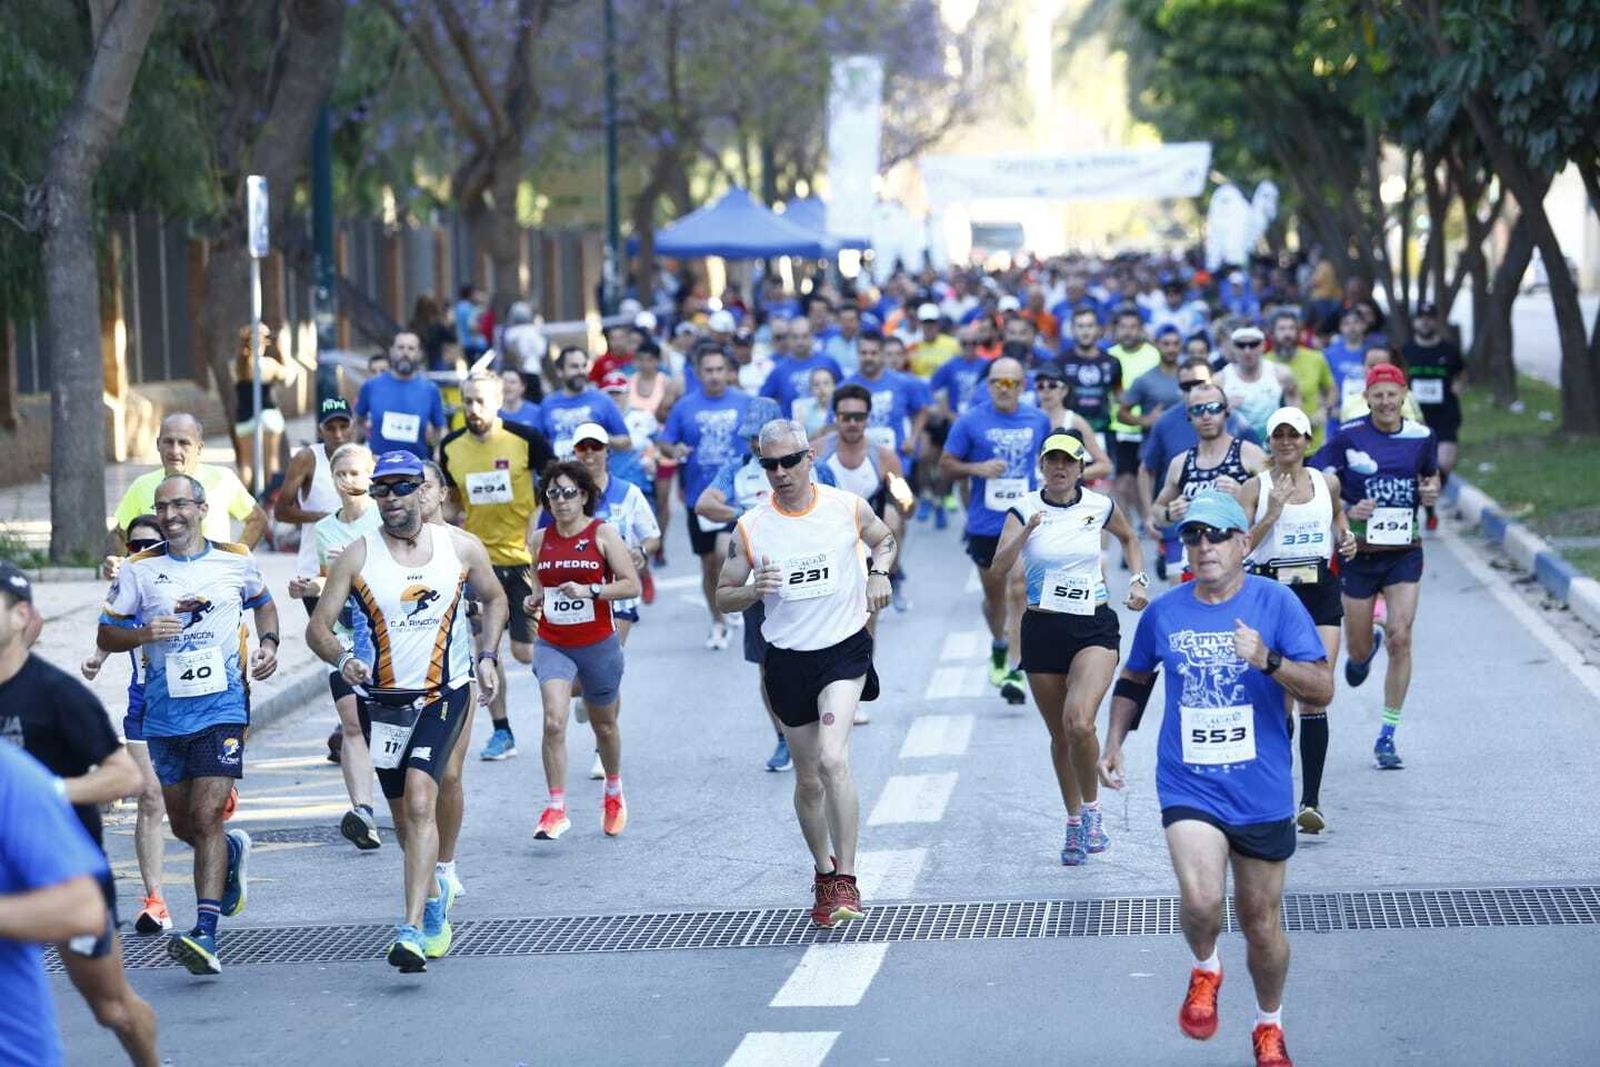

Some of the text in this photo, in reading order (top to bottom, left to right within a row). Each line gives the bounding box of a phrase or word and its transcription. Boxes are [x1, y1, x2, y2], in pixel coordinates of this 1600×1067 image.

[472, 483, 506, 494] 294
[1373, 521, 1408, 531] 494
[1281, 532, 1324, 545] 333
[537, 560, 600, 570] AN PEDRO
[789, 567, 829, 585] 231
[1054, 585, 1089, 600] 521
[554, 600, 585, 612] 100
[180, 666, 212, 680] 40
[1191, 727, 1247, 743] 553
[384, 740, 401, 754] 11
